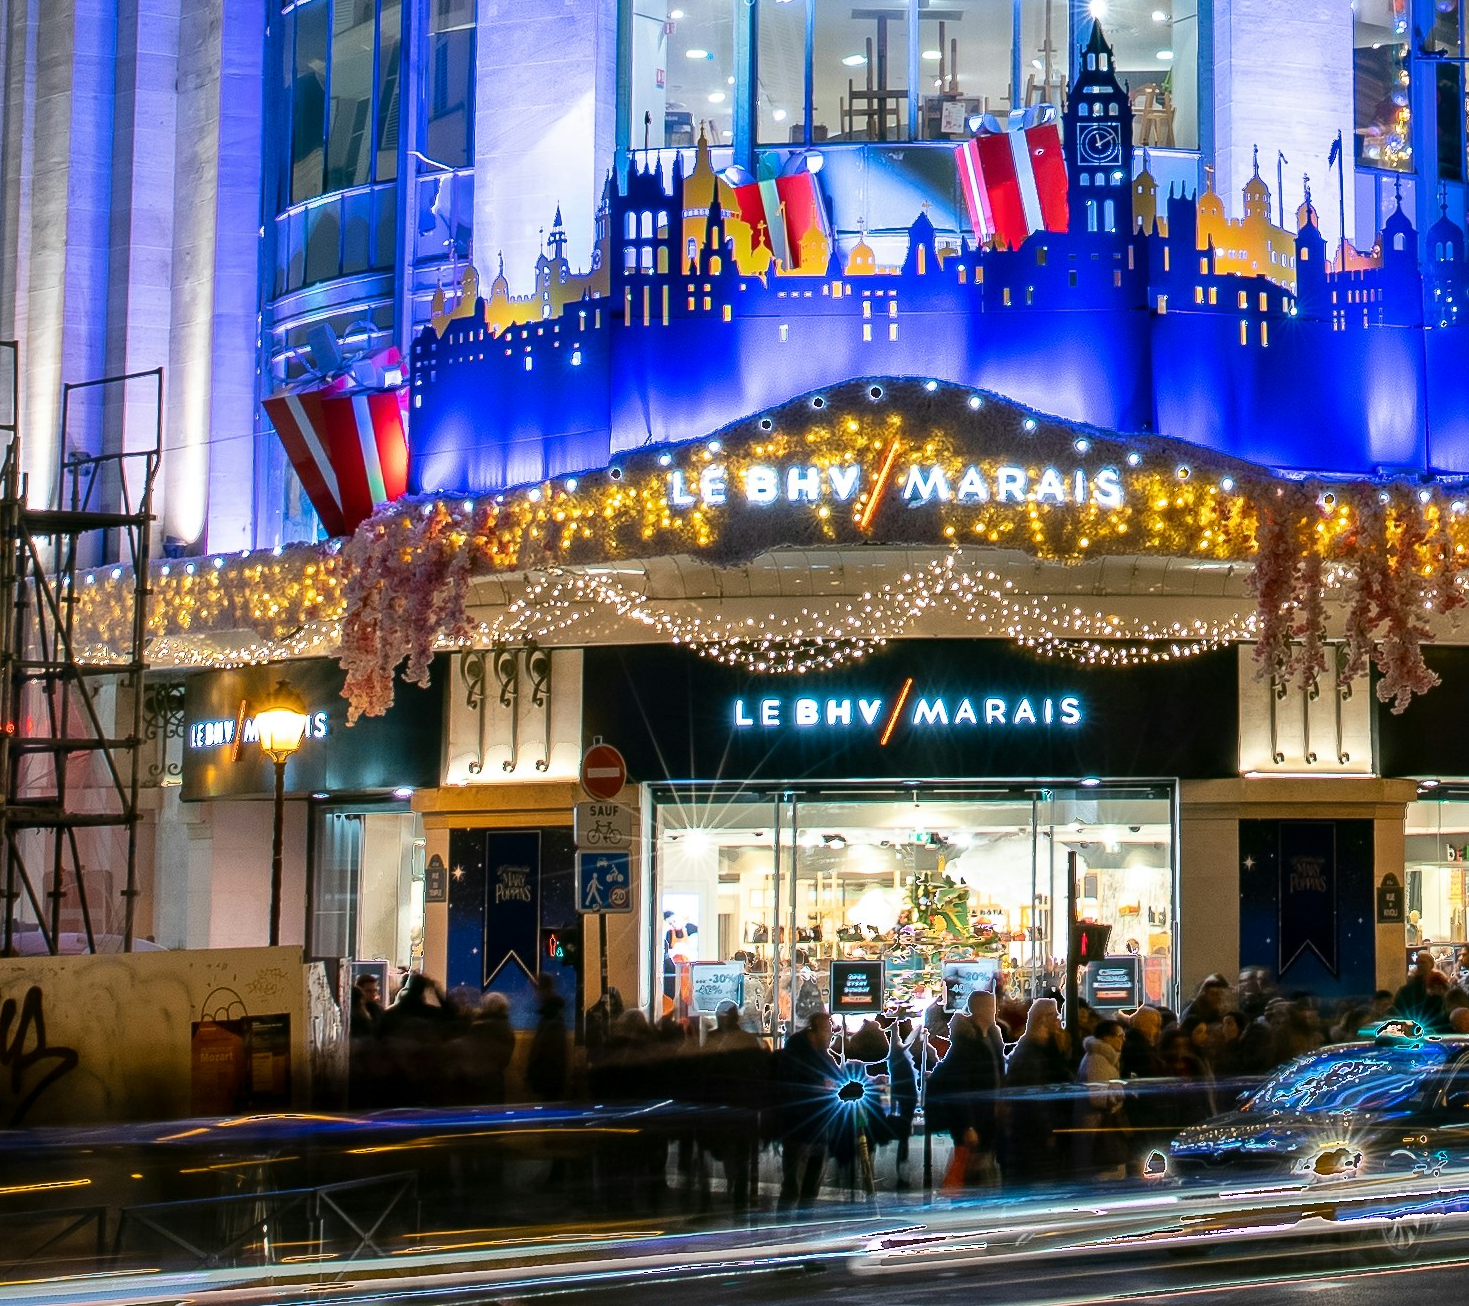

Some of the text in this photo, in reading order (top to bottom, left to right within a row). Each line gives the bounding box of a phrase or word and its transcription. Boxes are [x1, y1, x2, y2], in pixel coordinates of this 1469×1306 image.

[671, 464, 1126, 508] LE BHV MARAIS
[734, 697, 1082, 727] LE BHV MARAIS
[589, 805, 619, 816] SAUF
[495, 885, 531, 904] POPPINS
[614, 892, 625, 901] 20
